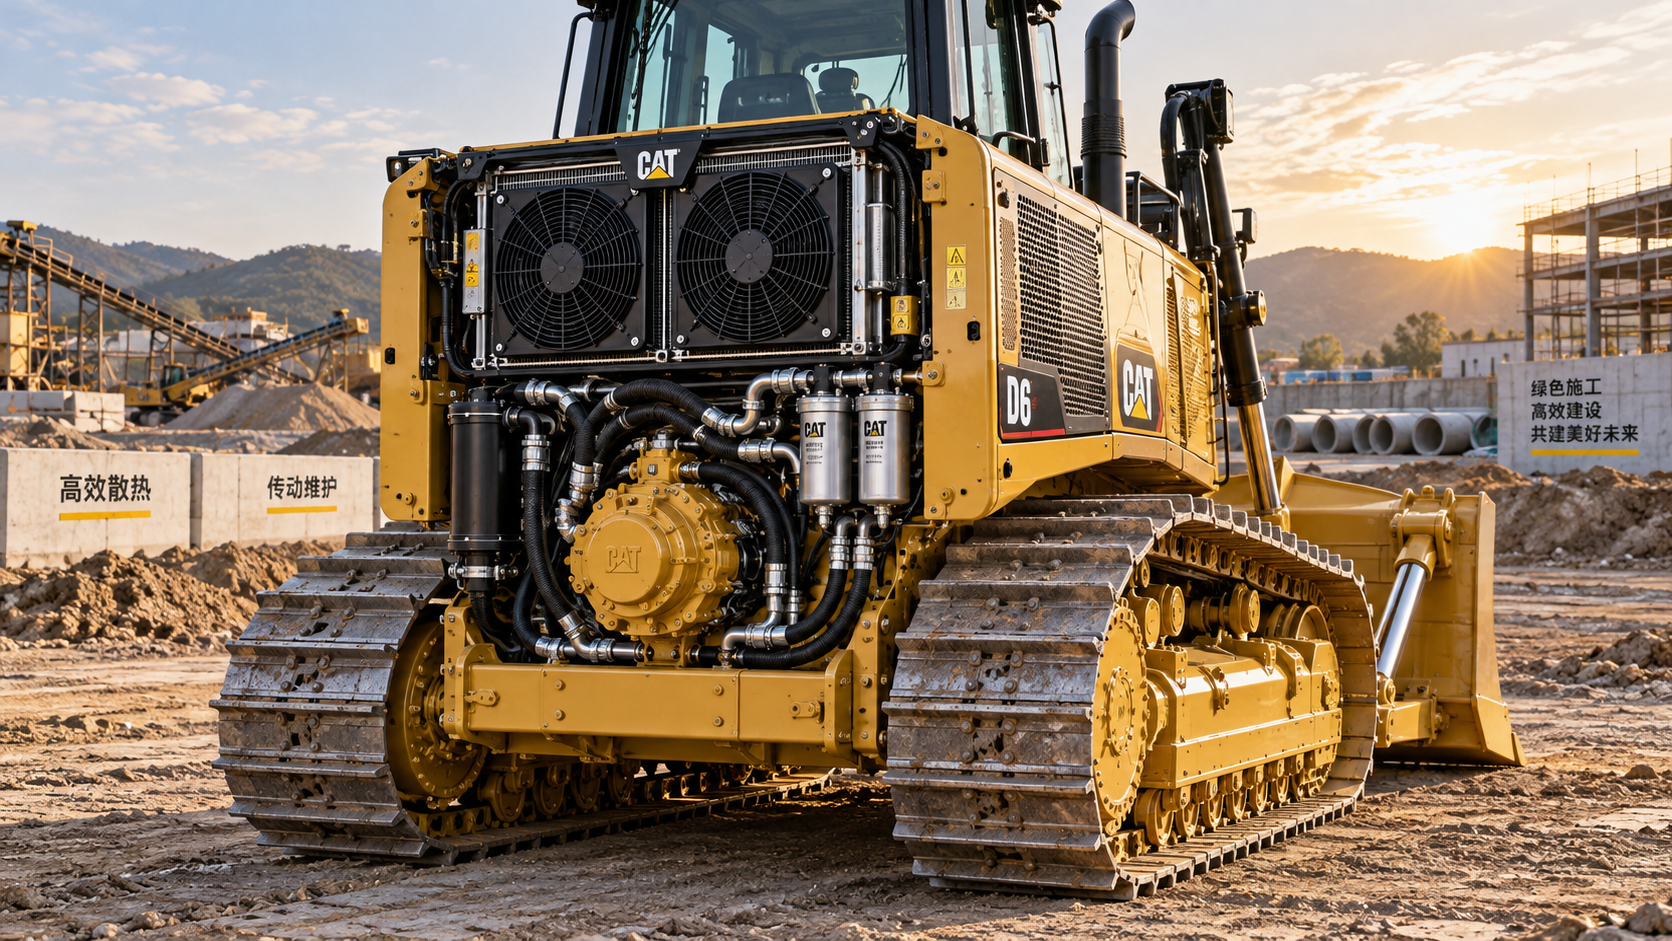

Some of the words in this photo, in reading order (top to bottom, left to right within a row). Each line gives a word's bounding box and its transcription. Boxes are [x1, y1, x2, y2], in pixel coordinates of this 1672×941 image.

[637, 149, 681, 180] CAT
[1122, 359, 1153, 420] CAT
[1531, 378, 1602, 397] 绿色施工
[1007, 375, 1031, 426] D6
[1531, 401, 1602, 420] 高效建设
[804, 421, 826, 437] CAT
[864, 420, 887, 436] CAT
[1531, 424, 1639, 443] 共建美好未来
[59, 474, 151, 503] 高效散热
[267, 475, 338, 500] 传动维护
[605, 545, 642, 574] CAT
